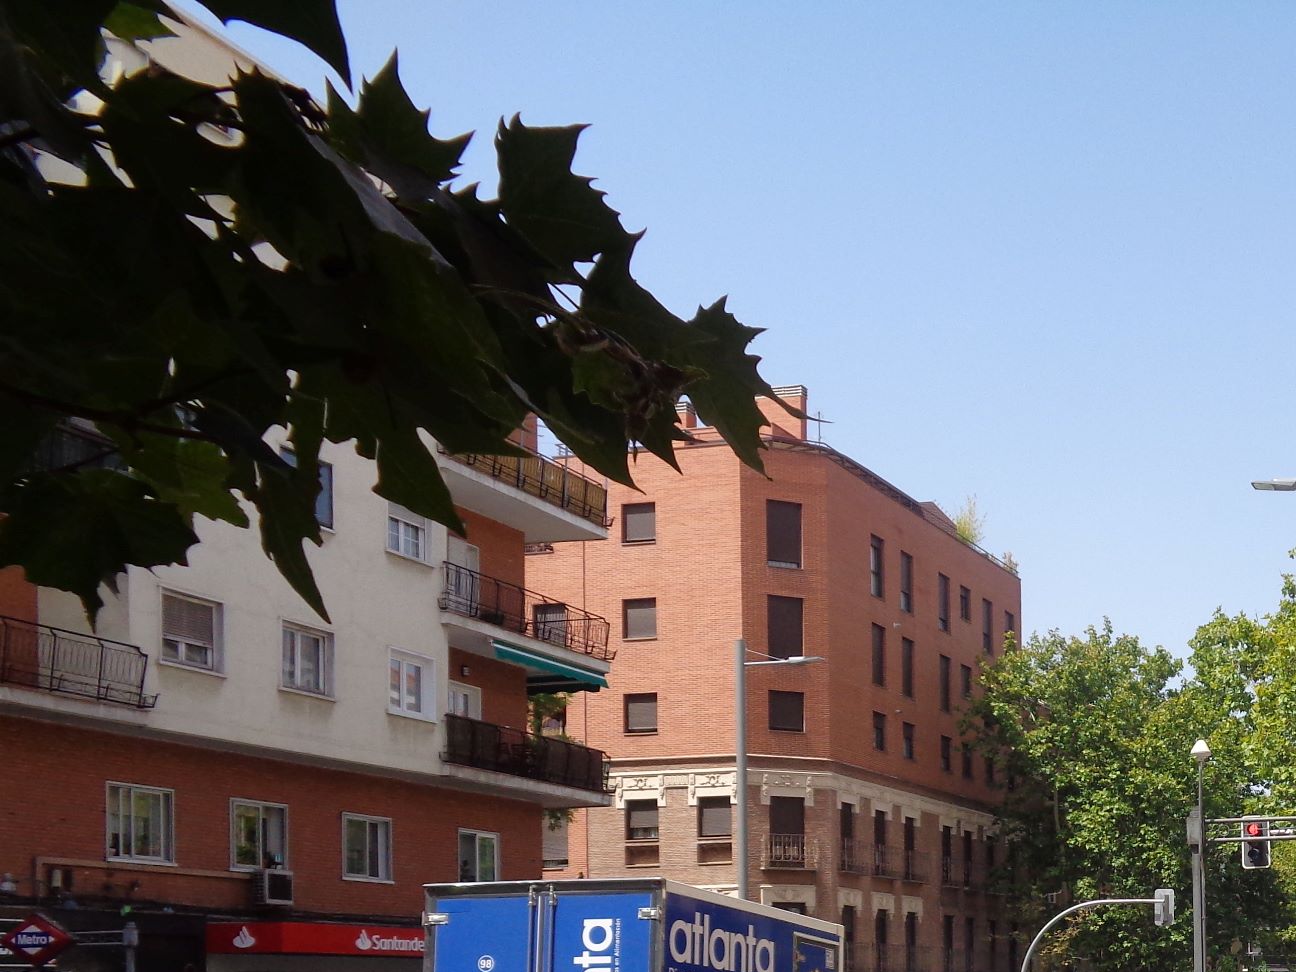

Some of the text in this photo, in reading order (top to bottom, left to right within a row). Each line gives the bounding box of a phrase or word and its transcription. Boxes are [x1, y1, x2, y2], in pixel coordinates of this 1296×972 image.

[17, 934, 48, 945] Metro
[372, 934, 425, 951] Santande
[480, 959, 492, 969] 98
